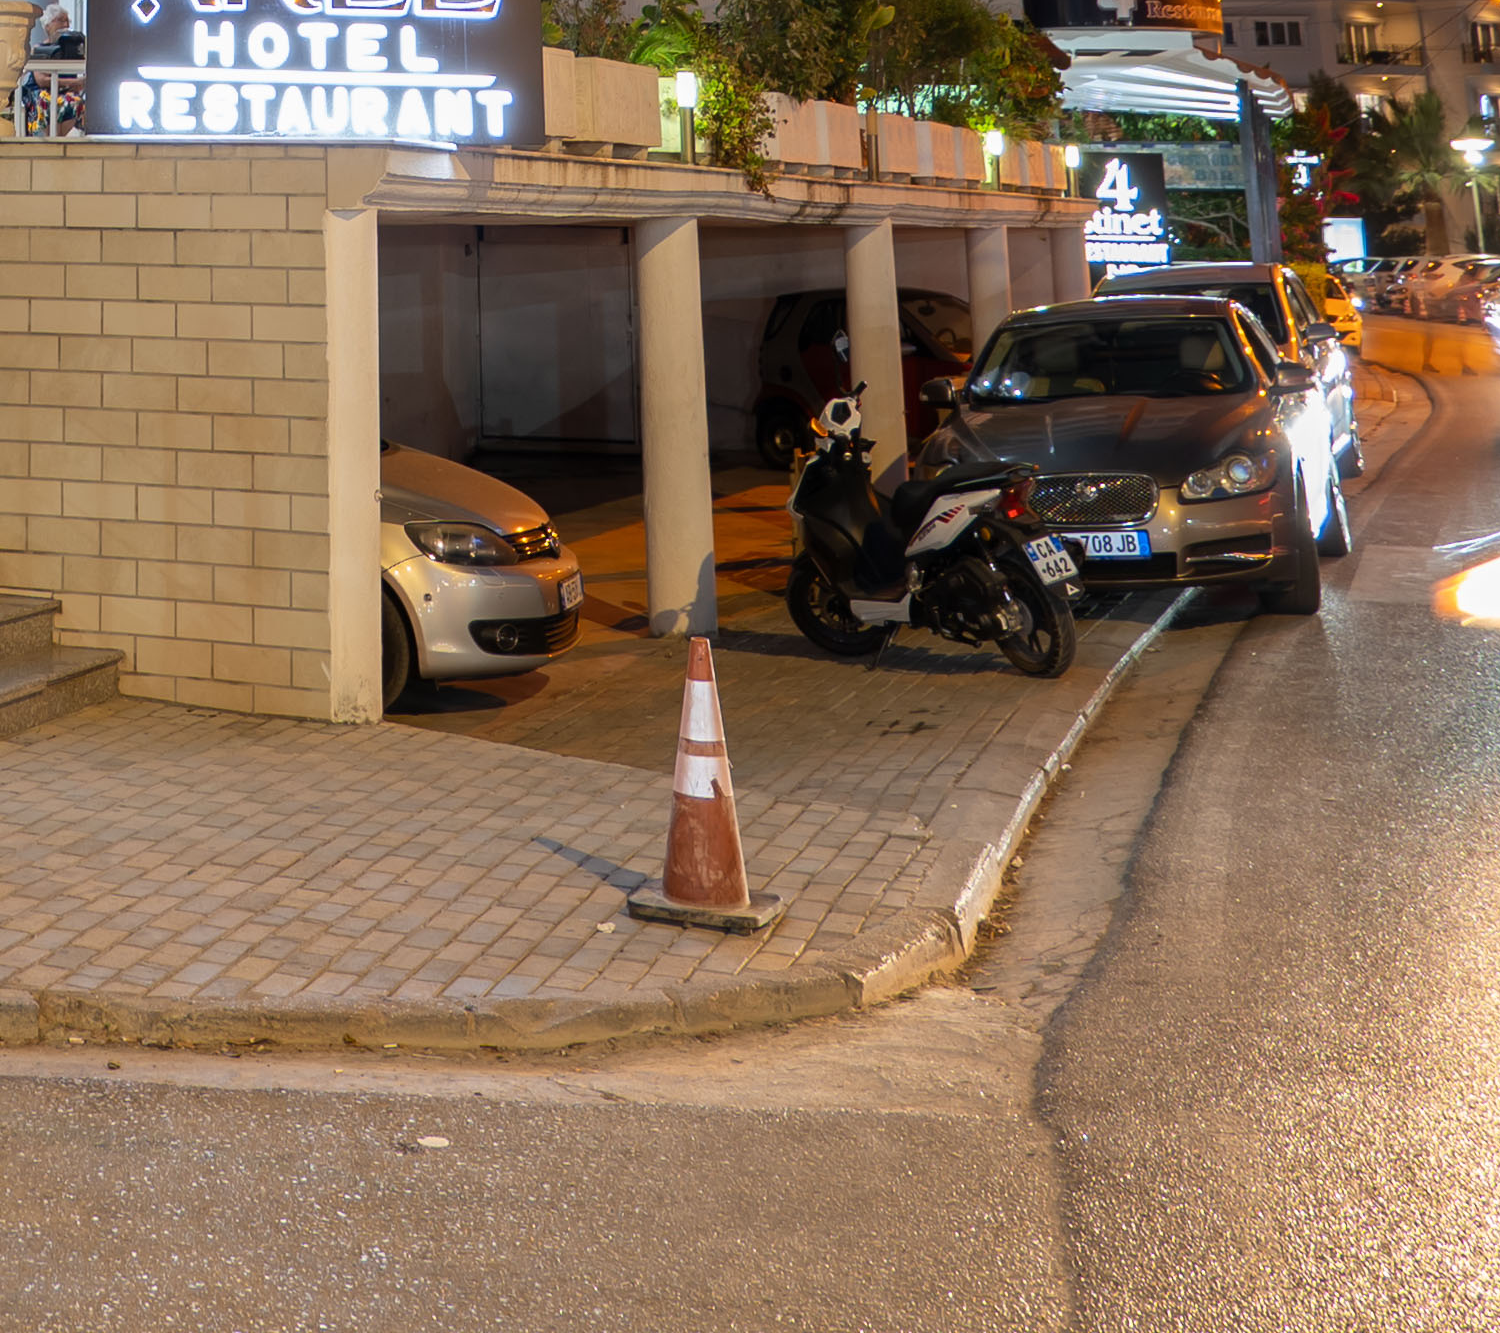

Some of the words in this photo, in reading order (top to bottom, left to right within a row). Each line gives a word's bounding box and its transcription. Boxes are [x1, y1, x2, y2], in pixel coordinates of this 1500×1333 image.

[194, 19, 440, 74] HOTEL
[118, 80, 513, 137] RESTAURANT
[1096, 157, 1139, 211] 4
[1036, 540, 1056, 559] CA
[1081, 534, 1113, 553] 708
[1117, 534, 1137, 553] JB
[1045, 556, 1073, 578] 642
